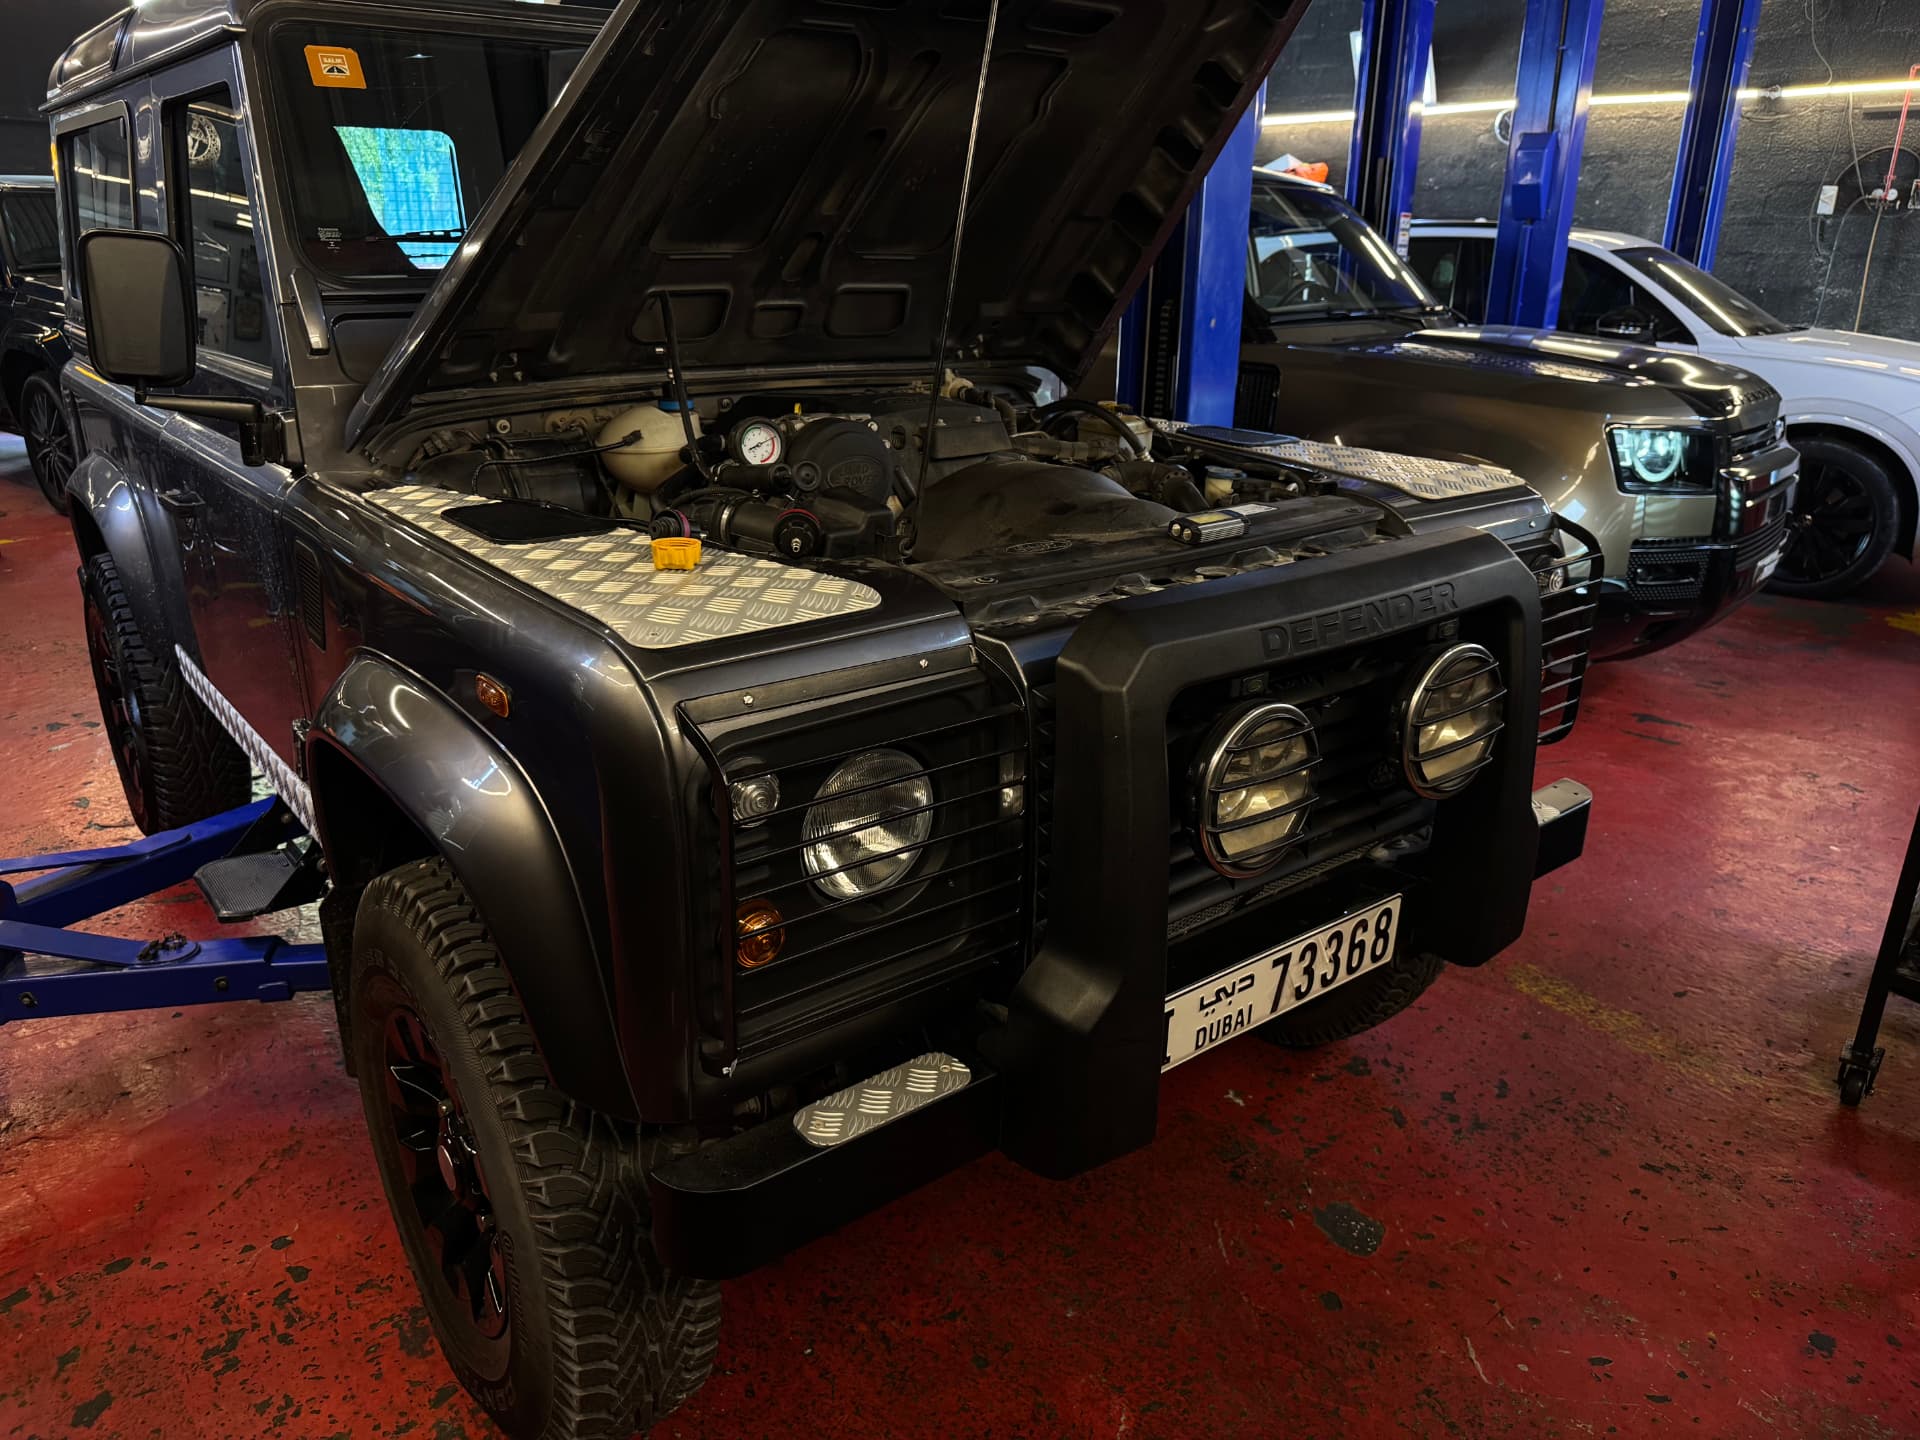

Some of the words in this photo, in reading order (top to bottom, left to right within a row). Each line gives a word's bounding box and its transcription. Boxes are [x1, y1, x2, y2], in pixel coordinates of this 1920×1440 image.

[1258, 581, 1459, 663] DEFENDER
[1269, 906, 1393, 1015] 73368
[1194, 1004, 1253, 1051] DUBAI
[1199, 972, 1255, 1019] دبي
